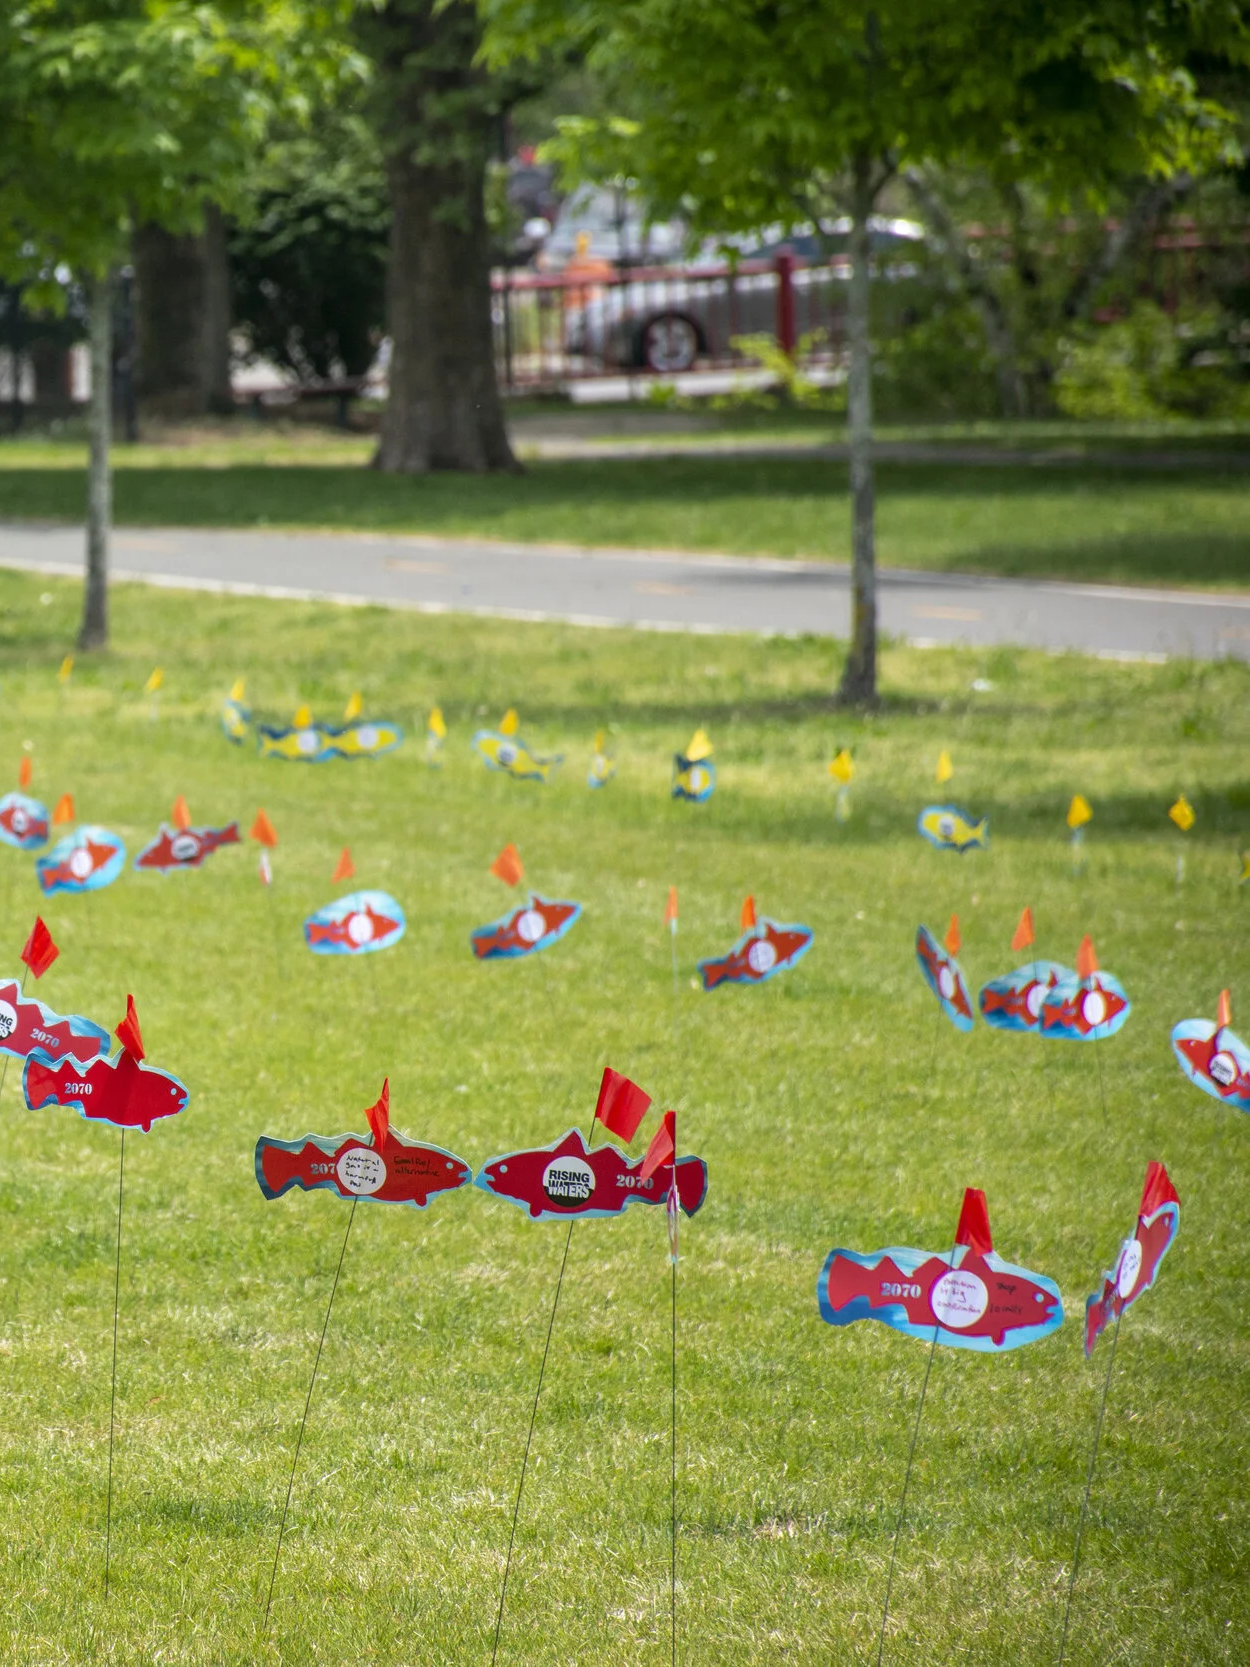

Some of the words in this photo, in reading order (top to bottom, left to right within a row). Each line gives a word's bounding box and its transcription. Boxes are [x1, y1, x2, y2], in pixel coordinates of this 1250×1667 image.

[30, 1027, 60, 1048] 2070
[64, 1082, 93, 1095] 2070
[310, 1162, 336, 1175] 207
[549, 1169, 590, 1183] RISING
[616, 1174, 654, 1189] 2070
[548, 1180, 590, 1199] WATERS
[881, 1282, 921, 1298] 2070
